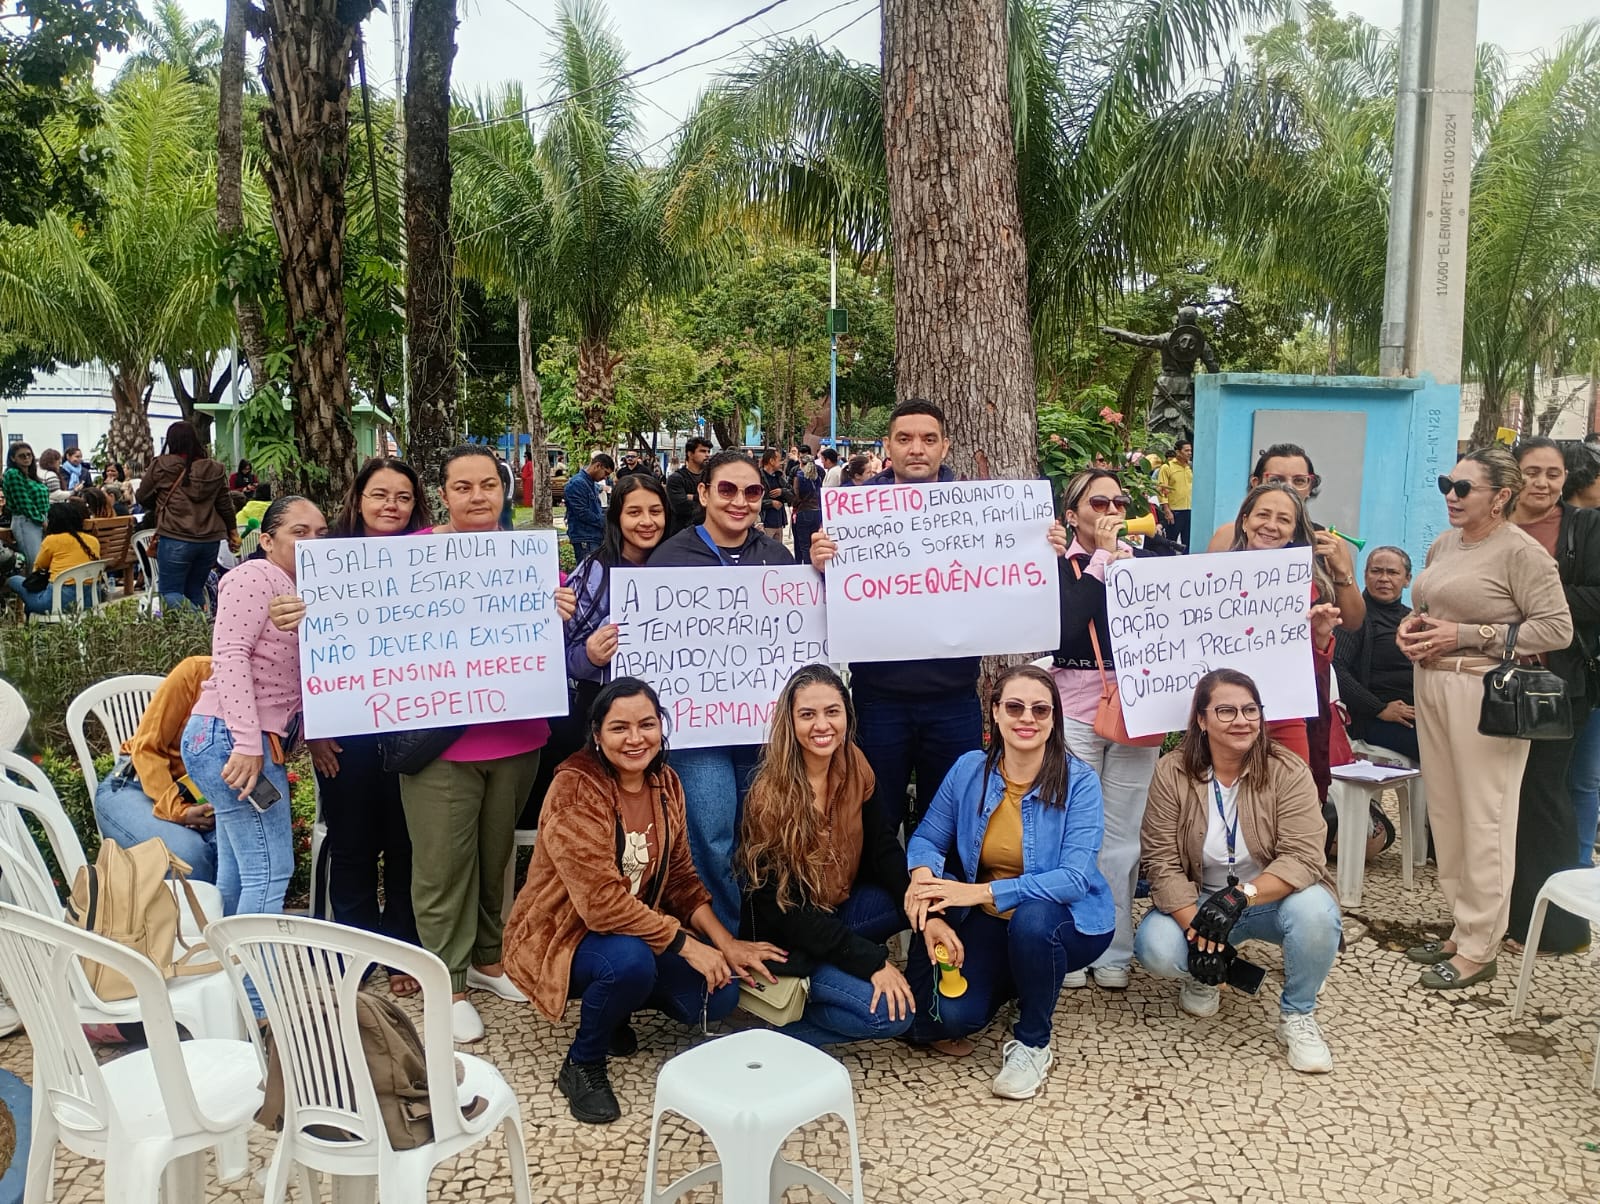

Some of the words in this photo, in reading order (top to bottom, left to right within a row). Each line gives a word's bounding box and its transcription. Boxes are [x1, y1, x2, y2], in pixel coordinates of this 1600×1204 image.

[824, 486, 928, 521] PREFEITO,
[929, 484, 1015, 507] ENQUANTO
[1023, 484, 1034, 500] A
[826, 515, 904, 543] EDUCAÇÃO
[911, 511, 979, 532] ESPERA,
[982, 500, 1054, 525] FAMÍLIAS
[327, 542, 393, 574] SALA
[408, 545, 437, 567] DE
[446, 535, 496, 562] AULA
[511, 534, 549, 559] NÃO
[831, 541, 911, 568] INTEIRAS
[921, 534, 985, 555] SOFREM
[995, 533, 1016, 549] AS
[300, 577, 399, 606] DEVERIA
[411, 571, 474, 594] ESTAR
[477, 565, 545, 588] VAZIA,
[621, 579, 639, 613] A
[656, 586, 710, 612] DOR
[717, 586, 748, 610] DA
[762, 570, 827, 606] GREV
[844, 560, 1047, 602] CONSEQUÊNCIAS.
[1254, 567, 1280, 590] DA
[305, 612, 348, 642] MAS
[358, 608, 369, 625] O
[376, 599, 465, 624] DESCASO
[472, 584, 557, 613] TAMBÉM
[787, 609, 803, 635] O
[1111, 605, 1169, 639] CAÇÃO
[1180, 606, 1212, 626] DAS
[1218, 594, 1305, 621] CRIANÇAS
[310, 634, 355, 674] NÃO
[369, 630, 458, 658] DEVERIA
[615, 644, 747, 677] ABANDONO
[758, 645, 785, 666] DA
[1057, 657, 1113, 668] PARIS
[1114, 633, 1185, 669] TAMBÉM
[1281, 623, 1309, 643] SER
[307, 674, 365, 696] QUEM
[373, 660, 456, 687] ENSINA
[467, 656, 546, 679] MERECE
[698, 668, 767, 694] DEIXA
[365, 689, 507, 728] RESPEITO.
